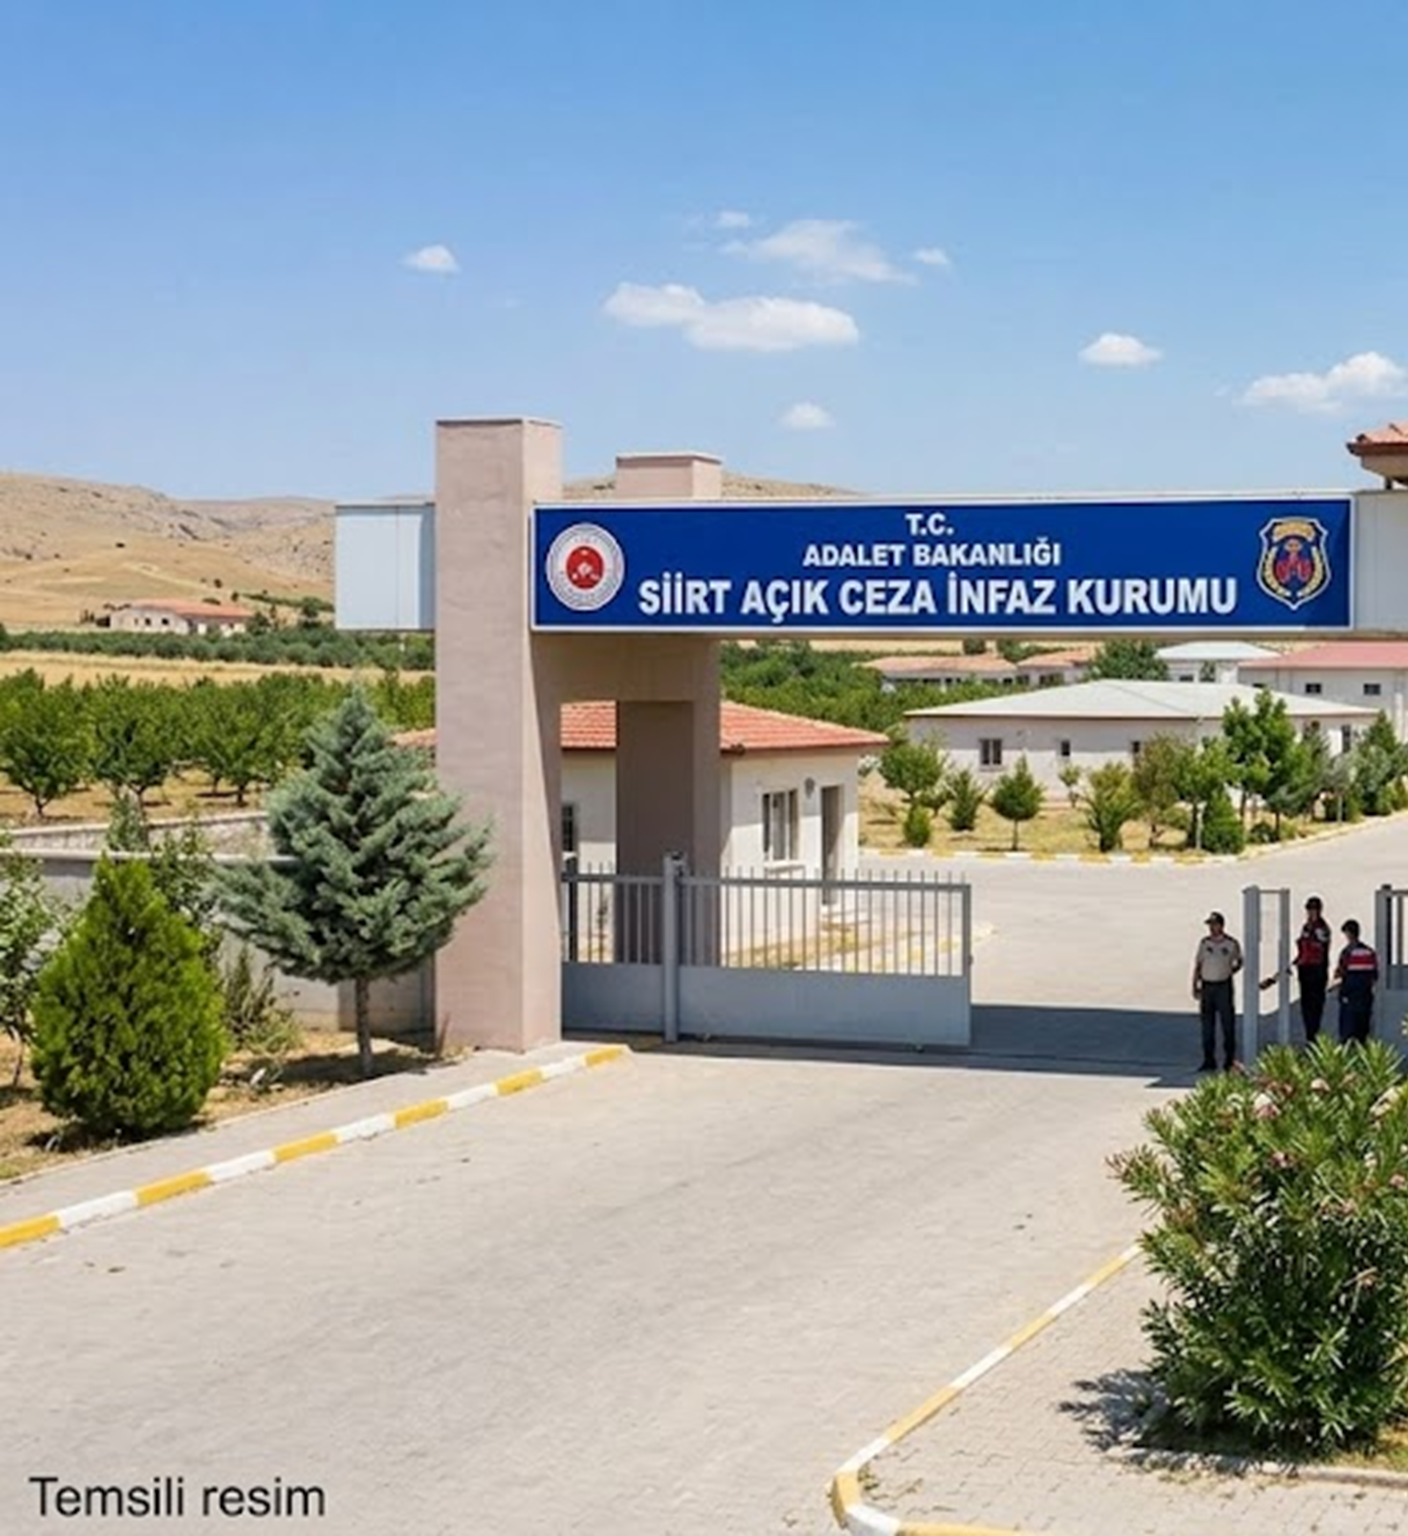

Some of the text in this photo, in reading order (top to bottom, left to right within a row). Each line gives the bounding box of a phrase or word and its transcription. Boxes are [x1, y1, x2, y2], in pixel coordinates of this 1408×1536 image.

[905, 513, 954, 536] T.C.
[803, 537, 1061, 567] ADALET BAKANLIĞI
[639, 571, 1236, 624] SİİRT AÇIK CEZA İNFAZ KURUMU
